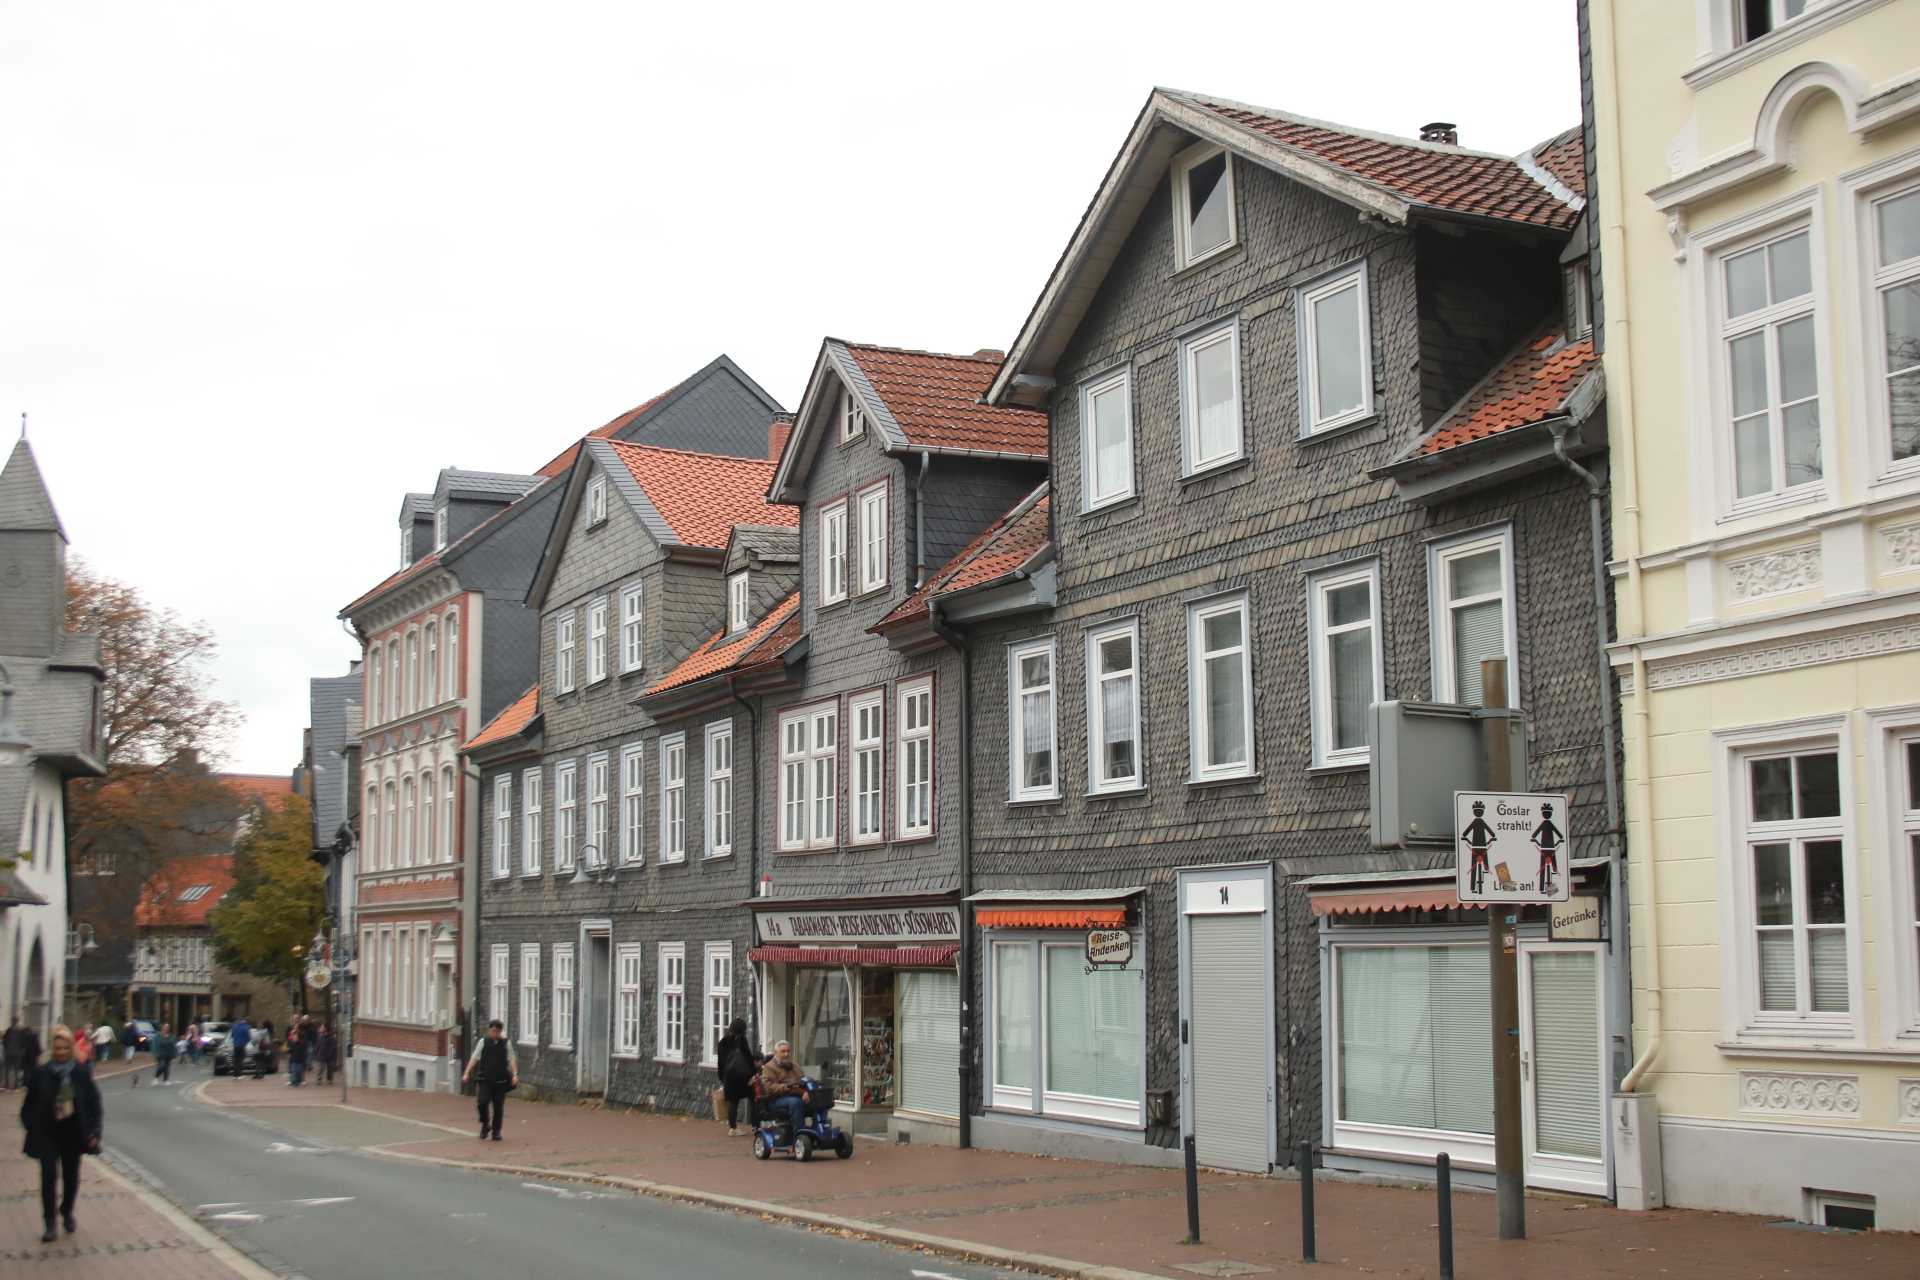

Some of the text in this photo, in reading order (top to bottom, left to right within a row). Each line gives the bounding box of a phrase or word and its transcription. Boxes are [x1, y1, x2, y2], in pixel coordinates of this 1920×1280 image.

[1497, 804, 1530, 816] Goslar
[1497, 821, 1532, 831] strahlt!
[1520, 881, 1535, 891] an!
[1219, 886, 1229, 905] 14
[788, 915, 838, 936] TABAKWAREN
[838, 913, 904, 936] REISEANDENKEN
[904, 909, 958, 935] SÜSSWAREN
[1553, 908, 1597, 929] Getränke
[1096, 931, 1124, 944] Reise-
[1090, 941, 1130, 957] Andenken
